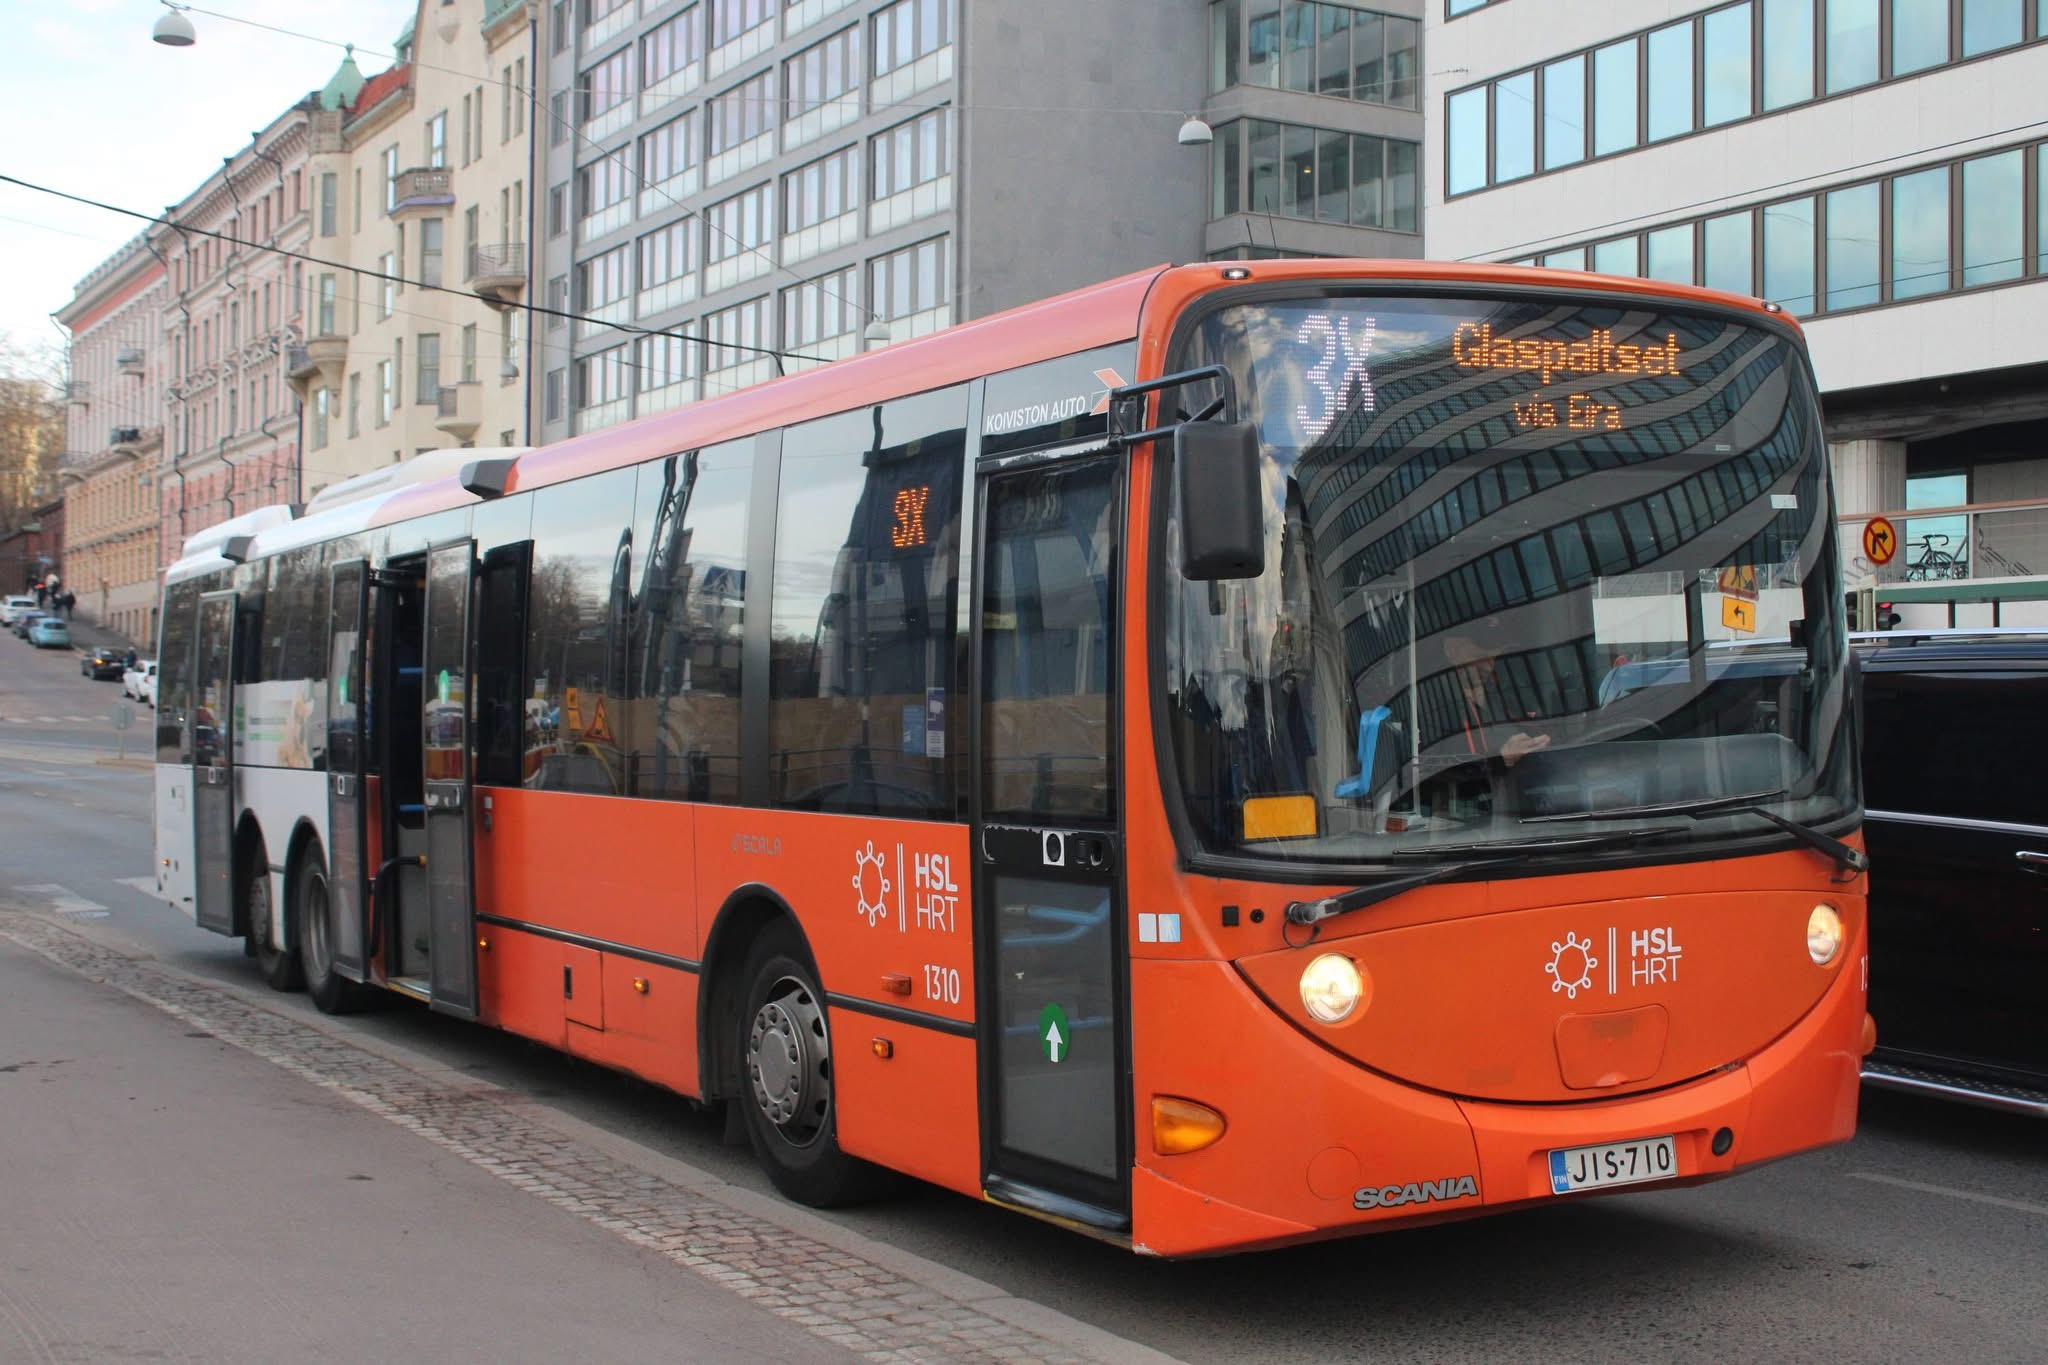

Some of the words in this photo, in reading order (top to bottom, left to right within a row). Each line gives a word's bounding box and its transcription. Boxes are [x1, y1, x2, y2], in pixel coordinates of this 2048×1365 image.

[1454, 322, 1681, 385] Glaspaltset
[1297, 314, 1376, 435] 3X
[986, 402, 1049, 433] KOIVISTON
[1050, 395, 1086, 419] AUTO
[1514, 393, 1557, 428] via
[1569, 395, 1622, 429] Eira
[893, 486, 929, 547] 3X
[914, 852, 958, 892] HSL
[916, 892, 959, 933] HRT
[1631, 926, 1682, 957] HSL
[924, 964, 960, 1004] 1310
[1632, 954, 1683, 986] HRT
[1554, 1175, 1568, 1185] FIN
[1573, 1143, 1670, 1182] JIS-710
[1353, 1175, 1479, 1210] SCANIA
